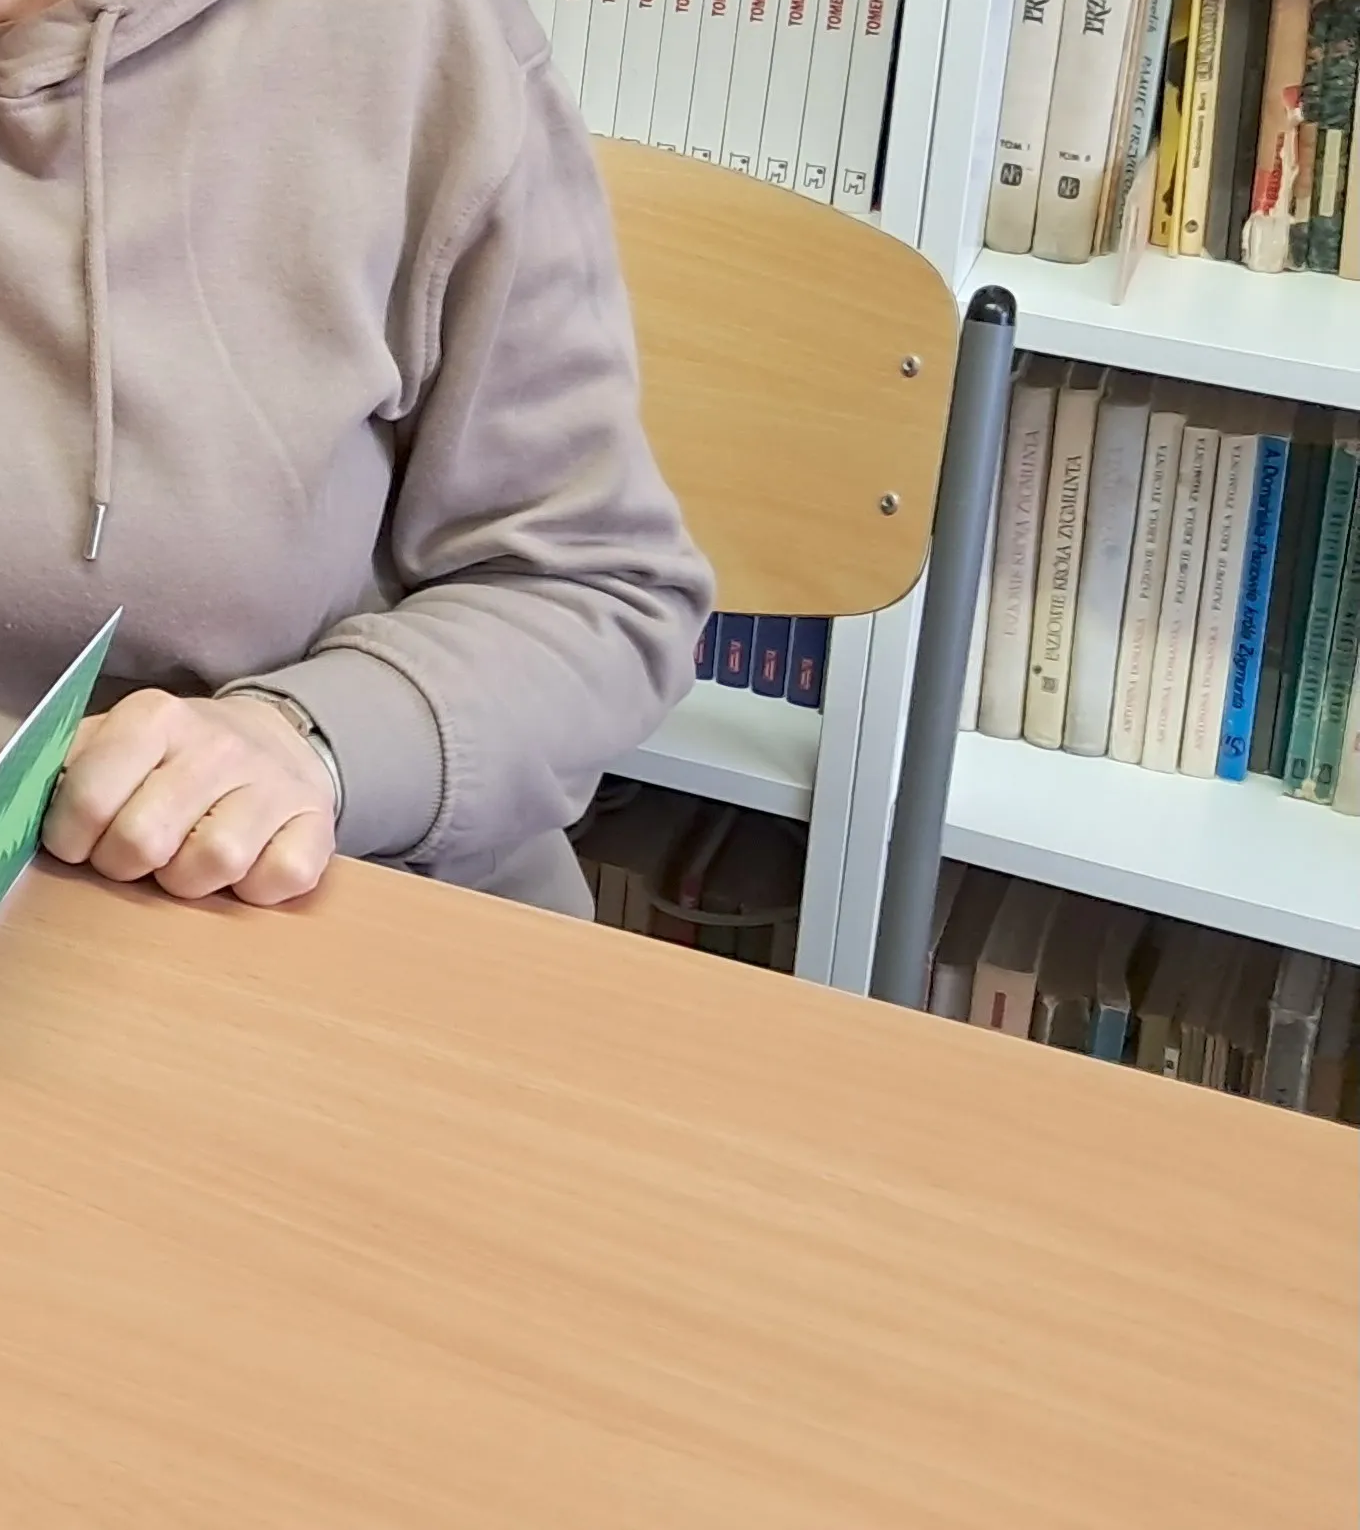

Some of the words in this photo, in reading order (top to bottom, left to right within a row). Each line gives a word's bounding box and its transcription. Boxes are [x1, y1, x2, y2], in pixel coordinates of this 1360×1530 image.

[999, 140, 1022, 151] TOM
[1058, 455, 1081, 539] ZYGMUNTA
[1053, 545, 1071, 591] KRÓLA
[1045, 599, 1064, 661] PAZIOWIE
[1225, 643, 1254, 711] Zygmunta
